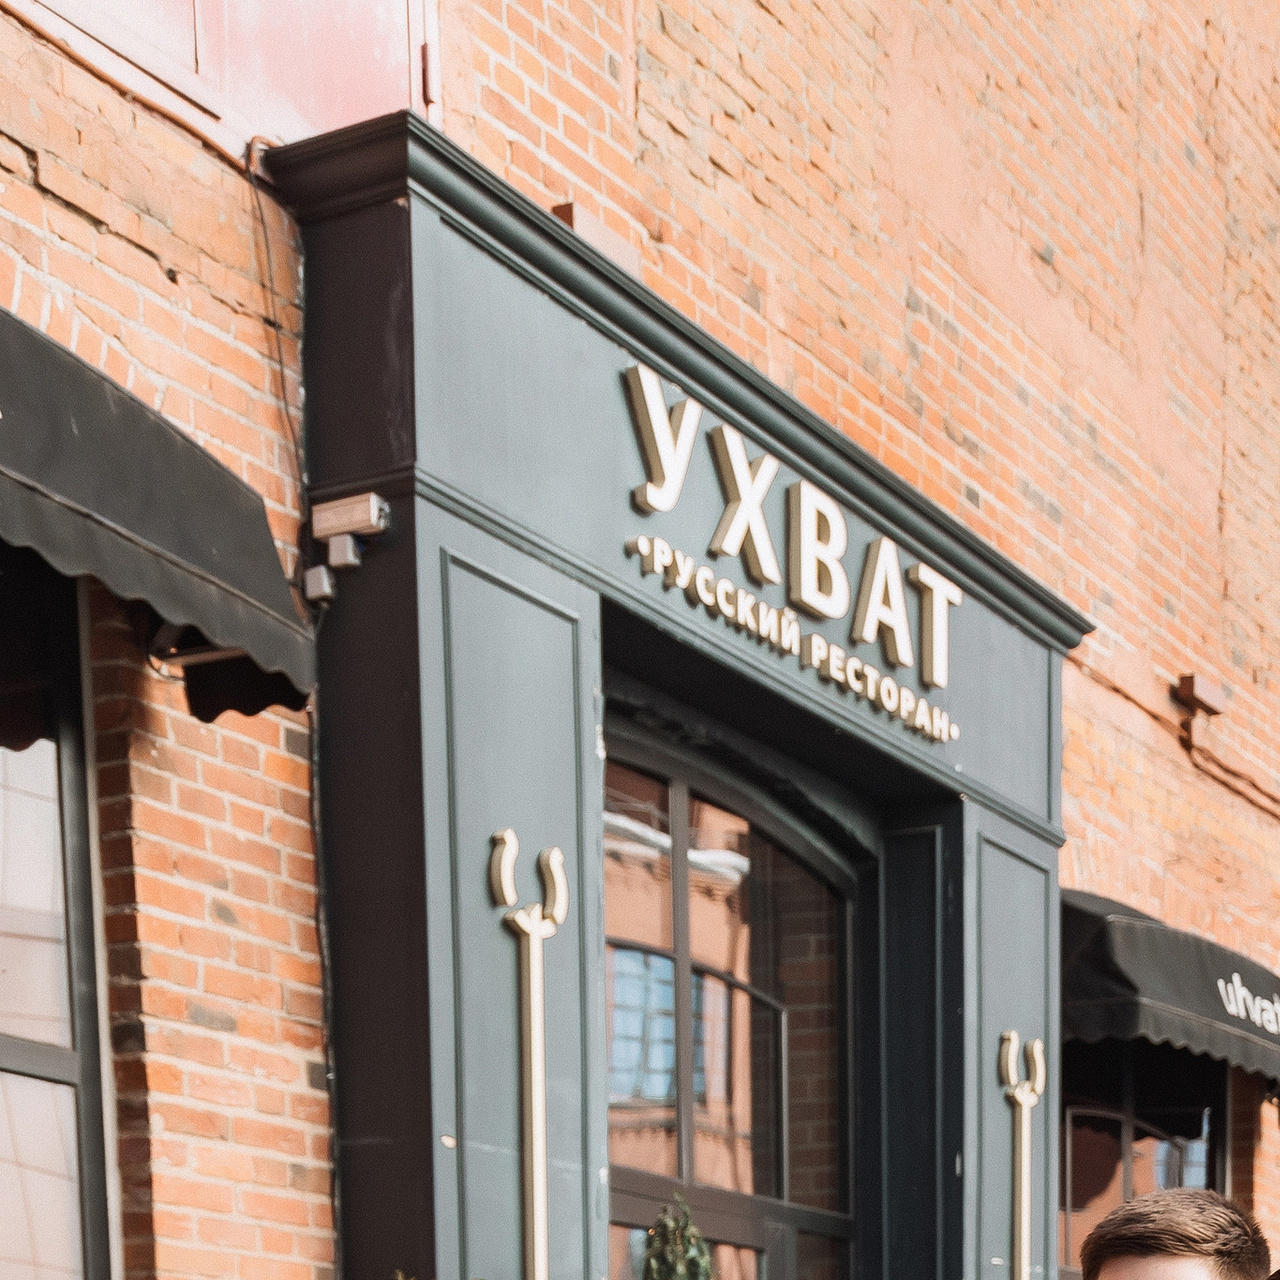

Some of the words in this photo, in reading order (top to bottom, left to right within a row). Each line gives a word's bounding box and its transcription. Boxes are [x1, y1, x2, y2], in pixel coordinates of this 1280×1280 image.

[628, 362, 963, 690] УХВАТ
[645, 536, 800, 656] РУССКИЙ
[805, 632, 951, 743] РЕСТОРАН
